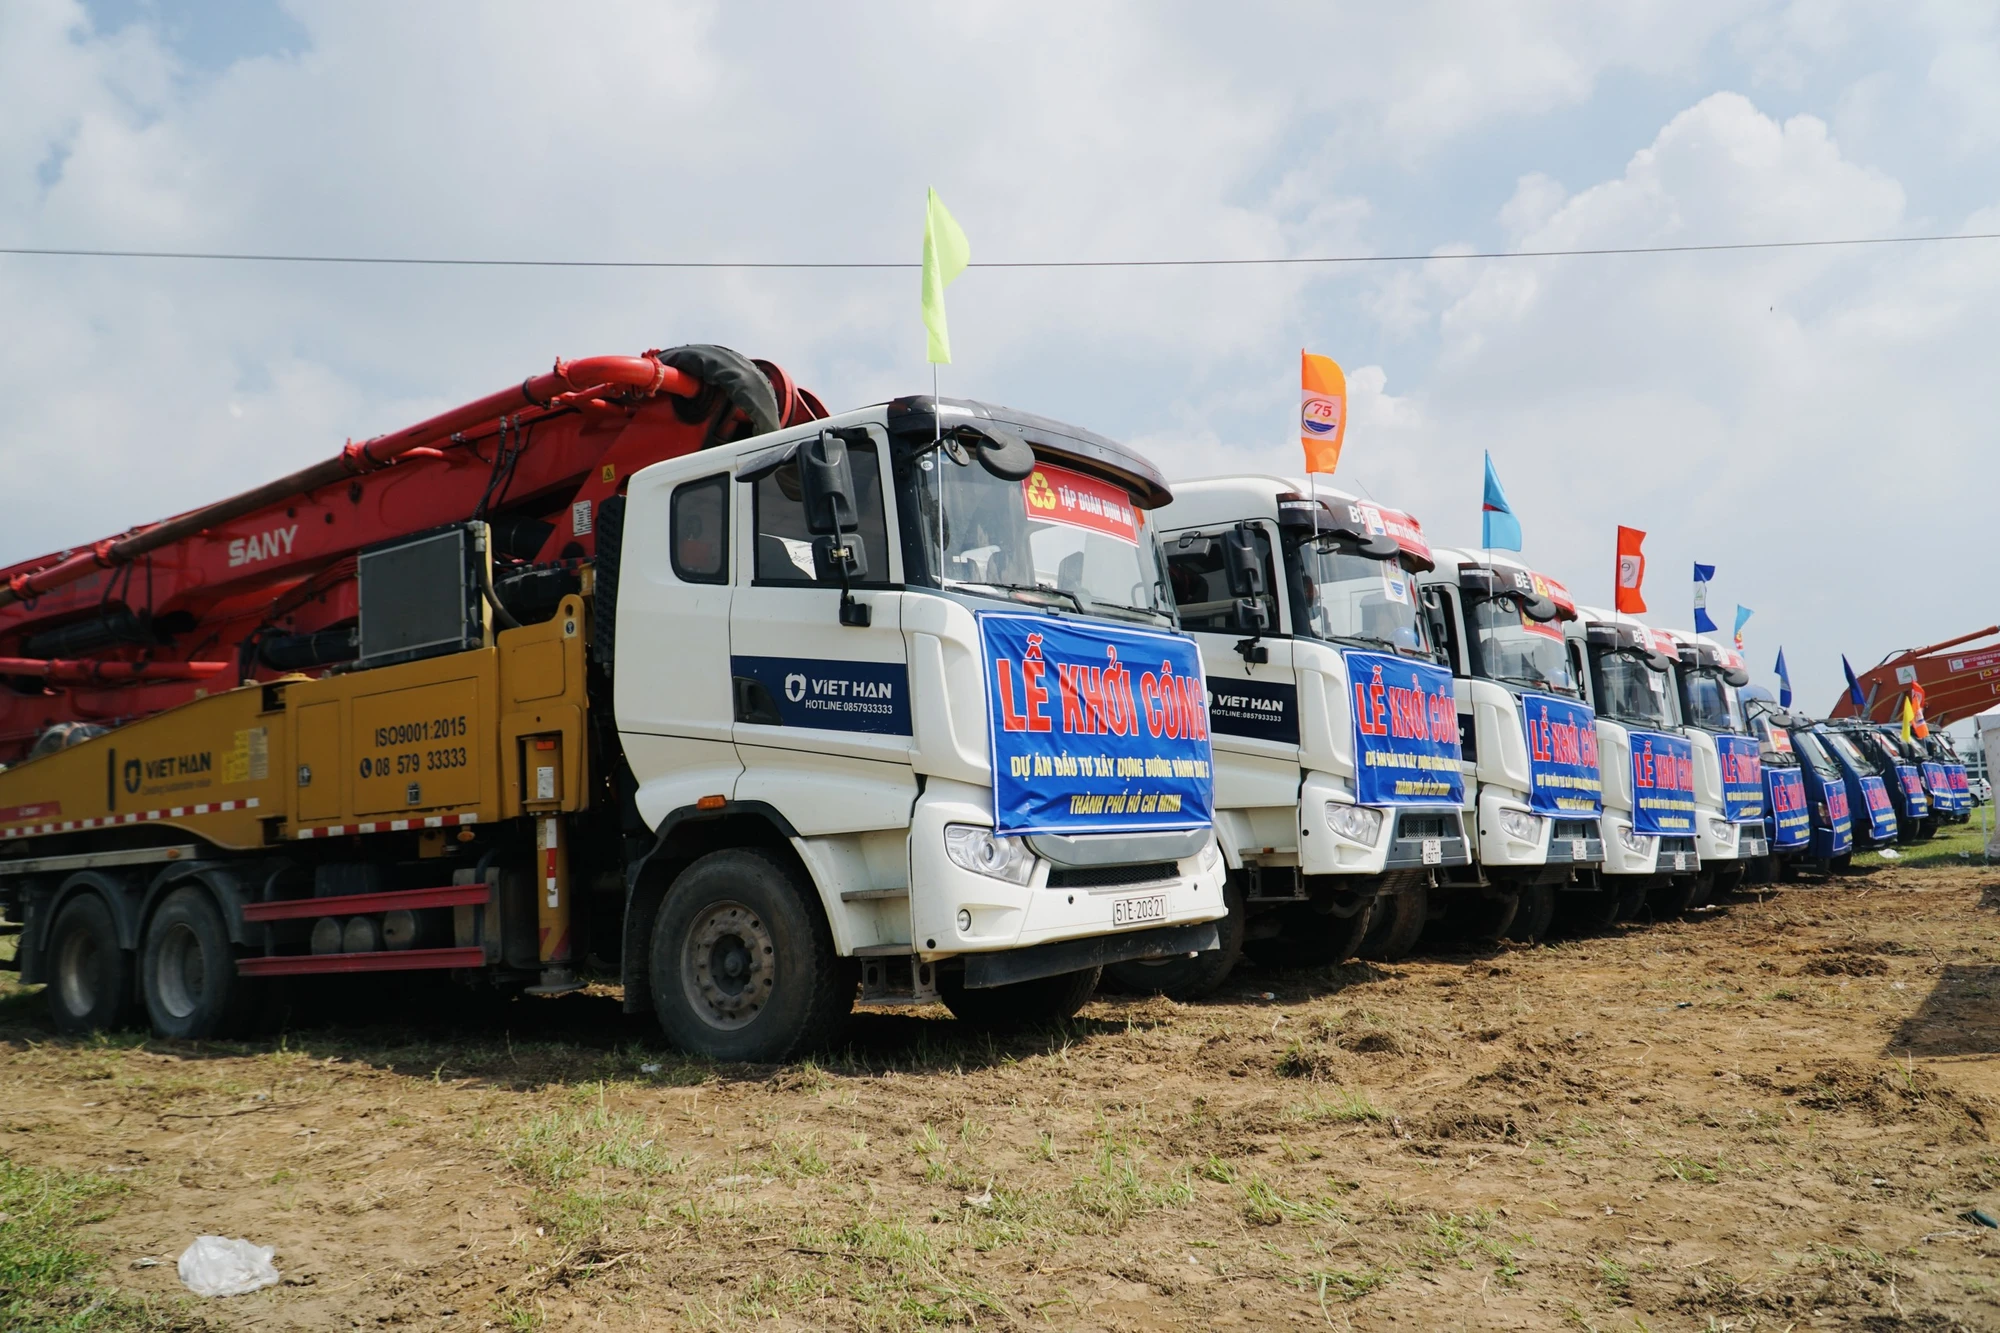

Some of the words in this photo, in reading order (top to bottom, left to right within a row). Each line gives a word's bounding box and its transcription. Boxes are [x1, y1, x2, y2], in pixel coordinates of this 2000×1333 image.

[1313, 403, 1332, 417] 75
[1057, 485, 1077, 511] TẬP
[228, 524, 298, 568] SANY
[852, 681, 892, 699] HAN
[996, 632, 1052, 734] LỄ
[1058, 644, 1139, 737] KHỞI
[1140, 659, 1208, 741] CÔNG
[1250, 697, 1284, 712] HAN
[1355, 665, 1387, 737] LỄ
[1389, 673, 1429, 741] KHỞI
[375, 716, 466, 747] ISO9001:2015
[1530, 705, 1551, 762] LỄ
[145, 757, 176, 779] VIET
[178, 752, 212, 775] HAN
[375, 757, 390, 777] 08
[397, 753, 420, 774] 579
[427, 747, 467, 770] 33333
[1010, 754, 1031, 781] DỰ
[1034, 752, 1052, 777] ÁN
[1053, 750, 1078, 777] ĐẦU
[1078, 755, 1094, 777] TƯ
[1093, 753, 1114, 777] XÂY
[1117, 755, 1144, 781] DỰNG
[1145, 754, 1172, 778] ĐƯỜNG
[1634, 740, 1654, 788] LỄ
[1069, 791, 1103, 814] THÀNH
[1104, 788, 1128, 814] PHỐ
[1126, 788, 1143, 814] HỒ
[1141, 790, 1160, 813] CHÍ
[1157, 794, 1182, 812] MINH
